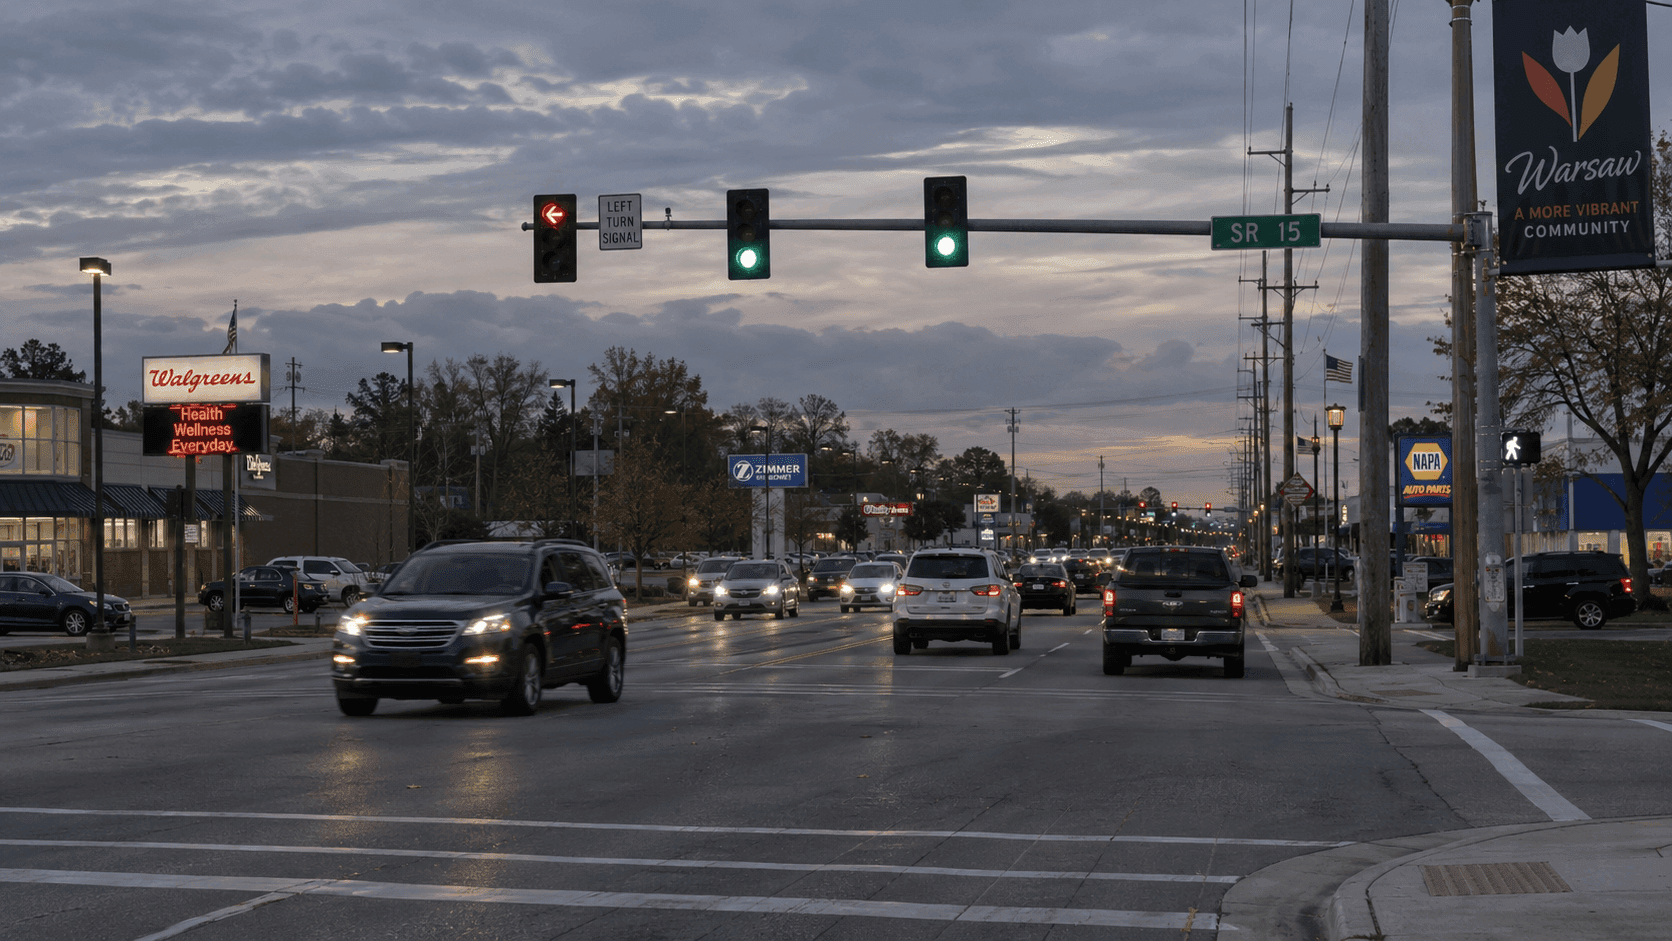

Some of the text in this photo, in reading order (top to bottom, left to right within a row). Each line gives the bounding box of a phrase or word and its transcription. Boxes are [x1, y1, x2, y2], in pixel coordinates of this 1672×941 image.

[1505, 145, 1642, 195] Warsaw
[607, 200, 633, 213] LEFT
[1514, 201, 1639, 221] A MORE VIBRANT
[606, 216, 634, 228] TURN
[1524, 220, 1630, 239] COMMUNITY
[602, 231, 640, 244] SIGNAL
[1230, 221, 1301, 243] SR 15
[149, 368, 256, 394] Walgreens
[181, 406, 223, 421] Health
[173, 422, 232, 437] Wellness
[171, 438, 235, 454] Everyday
[755, 464, 801, 474] ZIMMER
[1413, 453, 1442, 471] NAPA
[1403, 485, 1425, 495] AUTO
